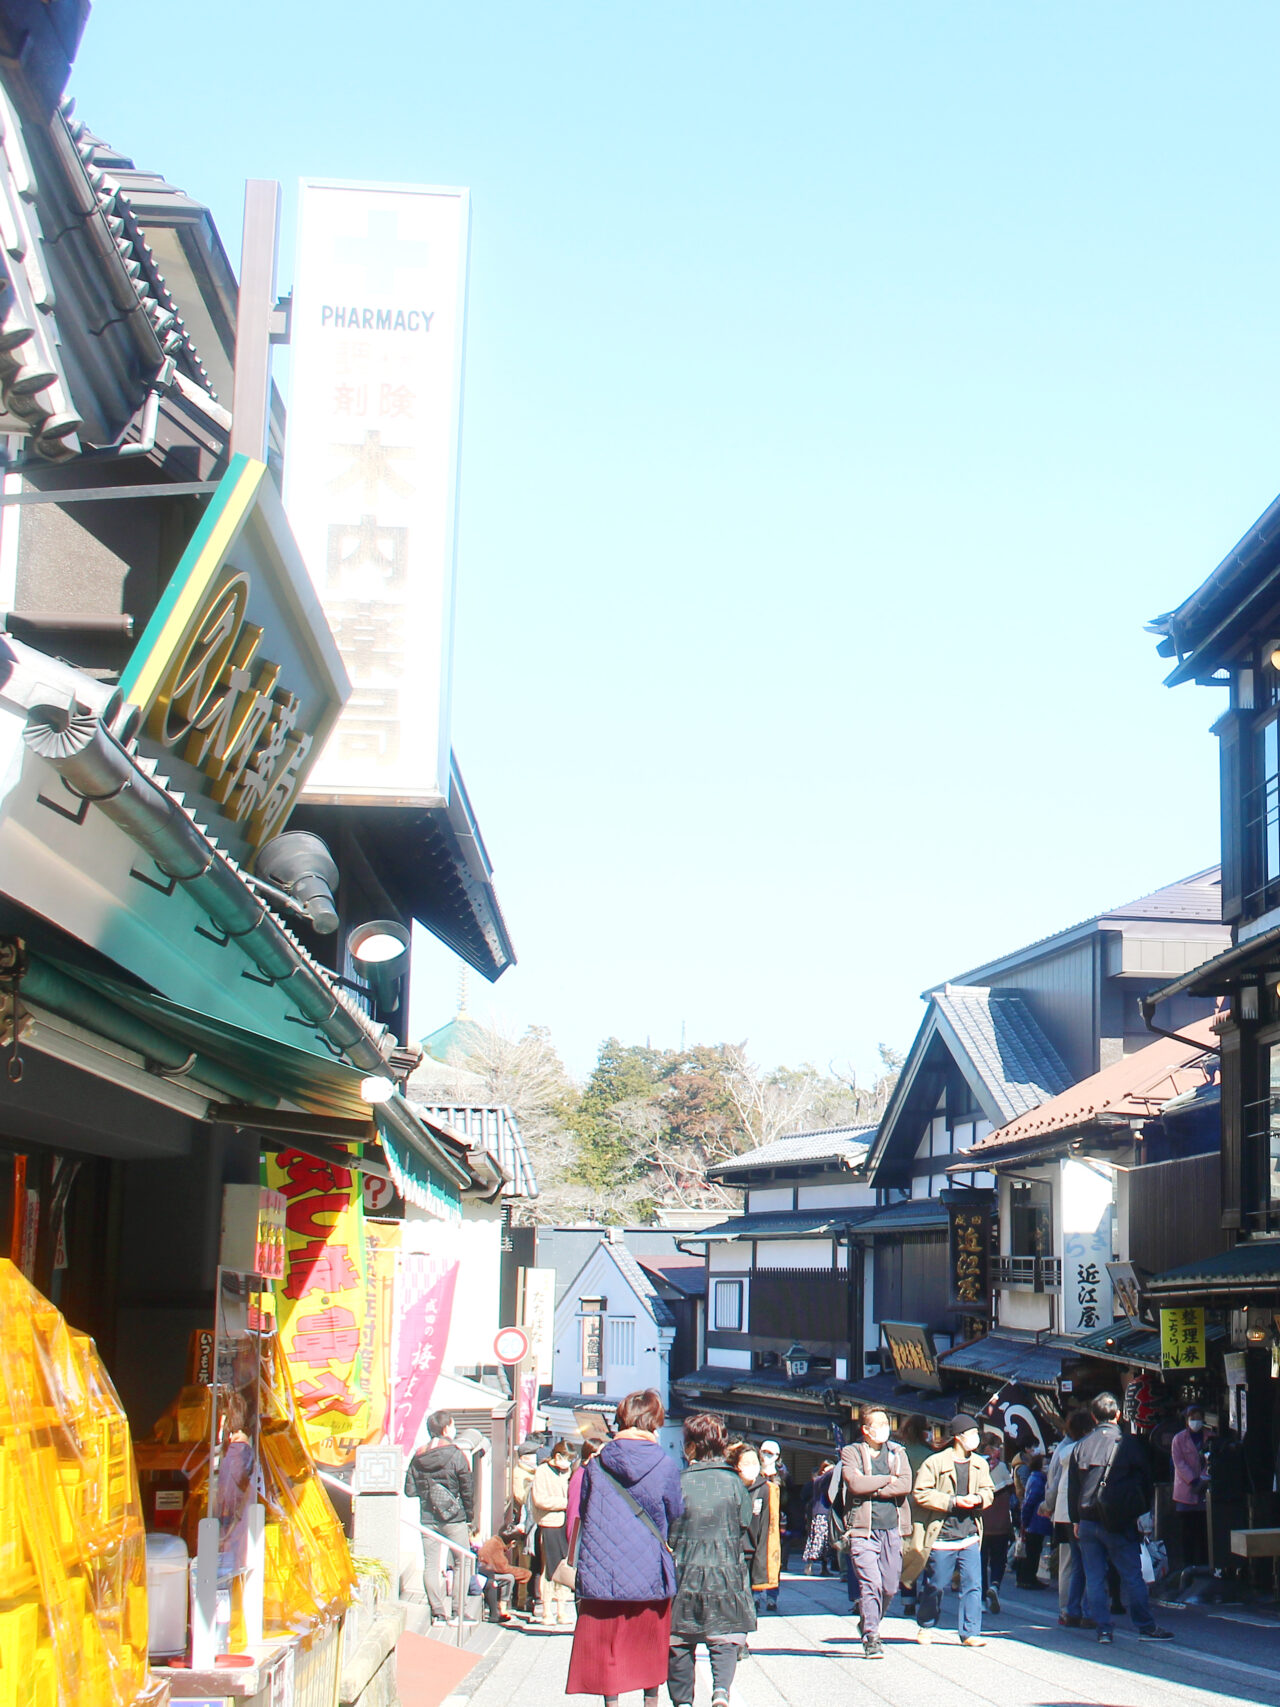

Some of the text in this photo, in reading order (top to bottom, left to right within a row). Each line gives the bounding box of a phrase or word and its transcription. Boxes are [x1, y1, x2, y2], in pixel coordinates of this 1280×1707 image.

[320, 305, 436, 333] PHARMACY
[956, 1226, 984, 1303] 近江屋
[530, 1290, 545, 1344] たちばな
[1076, 1262, 1102, 1329] 近江屋
[501, 1337, 524, 1355] 20
[1168, 1311, 1180, 1345] こちら
[1181, 1308, 1201, 1364] 整理券
